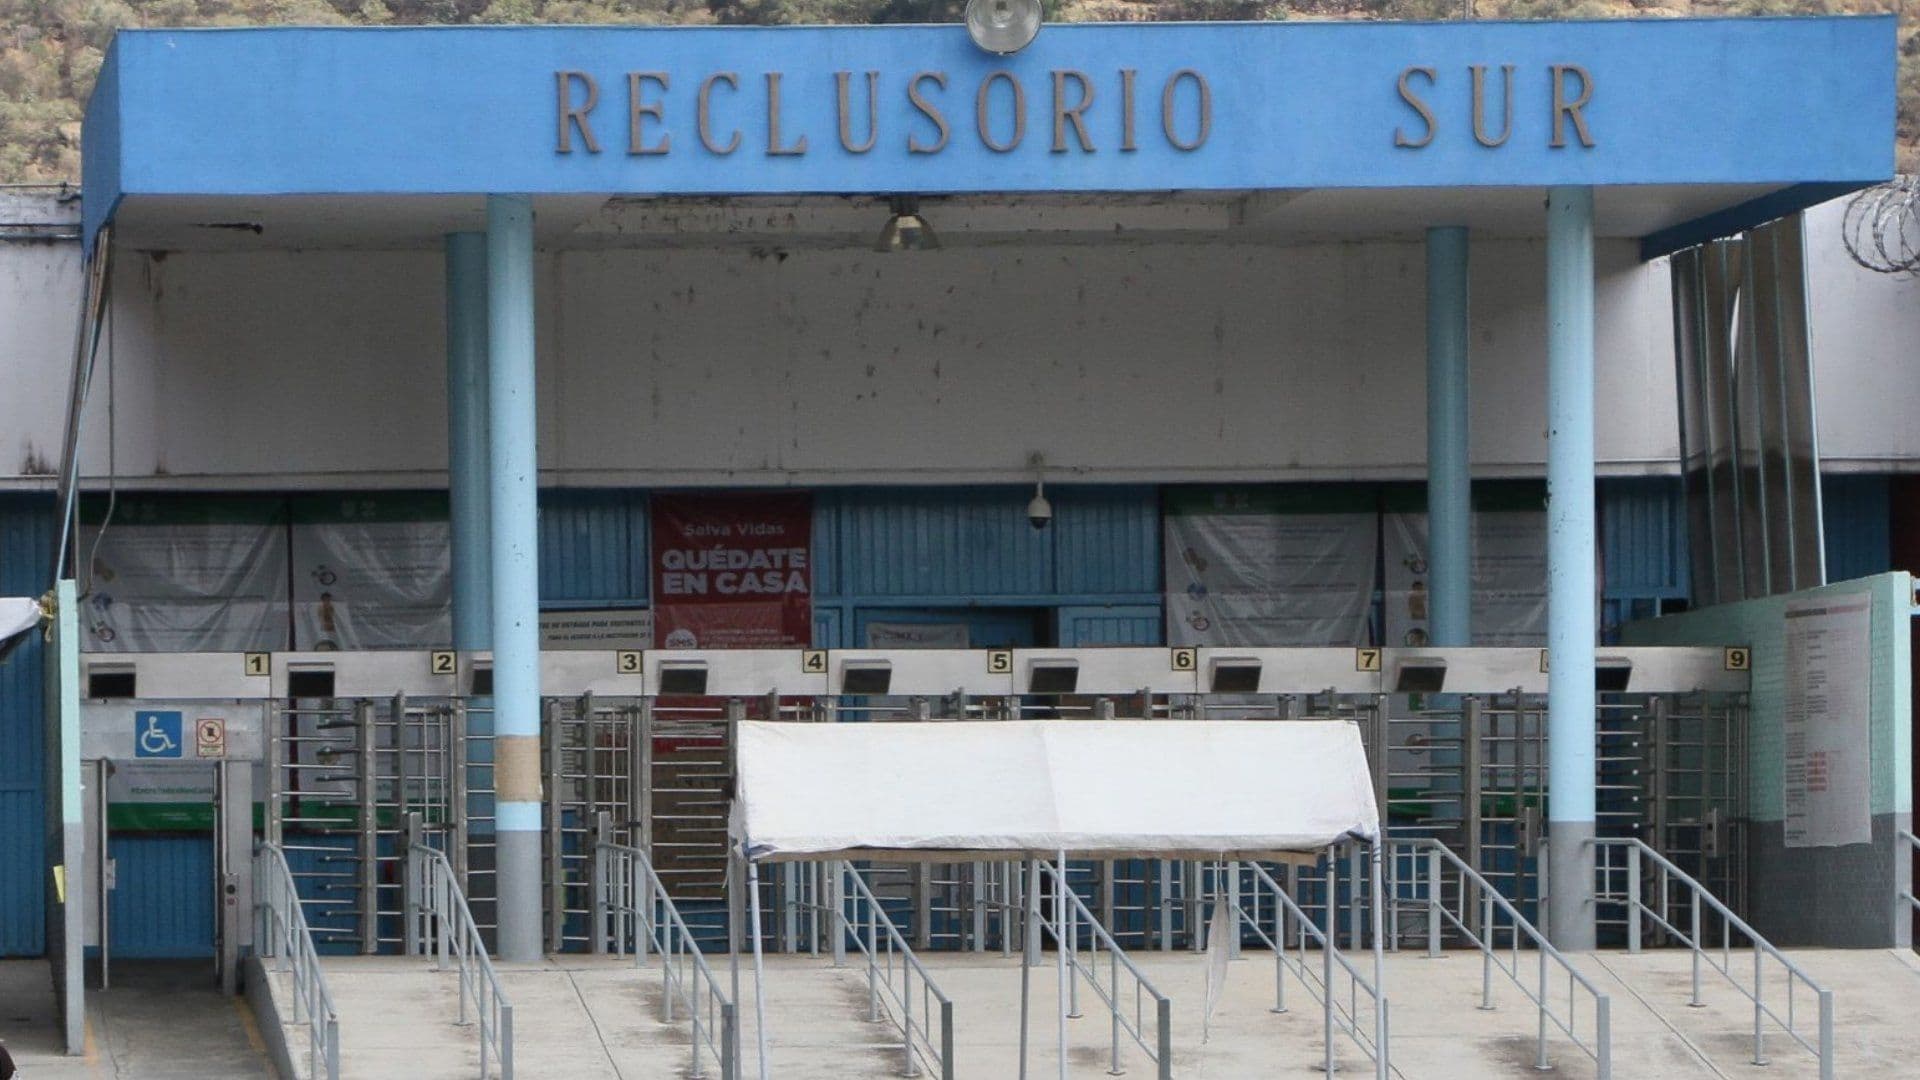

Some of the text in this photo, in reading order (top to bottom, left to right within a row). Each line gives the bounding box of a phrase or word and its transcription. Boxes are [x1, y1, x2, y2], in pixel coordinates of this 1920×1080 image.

[557, 64, 1596, 156] RECLUSORIO SUR
[683, 522, 784, 536] Salva Vidas
[661, 544, 807, 570] QUÉDATE
[662, 571, 808, 594] EN CASA
[251, 656, 261, 671] 1
[438, 655, 452, 670] 2
[623, 655, 637, 670] 3
[808, 654, 822, 669] 4
[994, 653, 1007, 669] 5
[1176, 652, 1190, 667] 6
[1362, 651, 1376, 667] 7
[1731, 651, 1745, 667] 9
